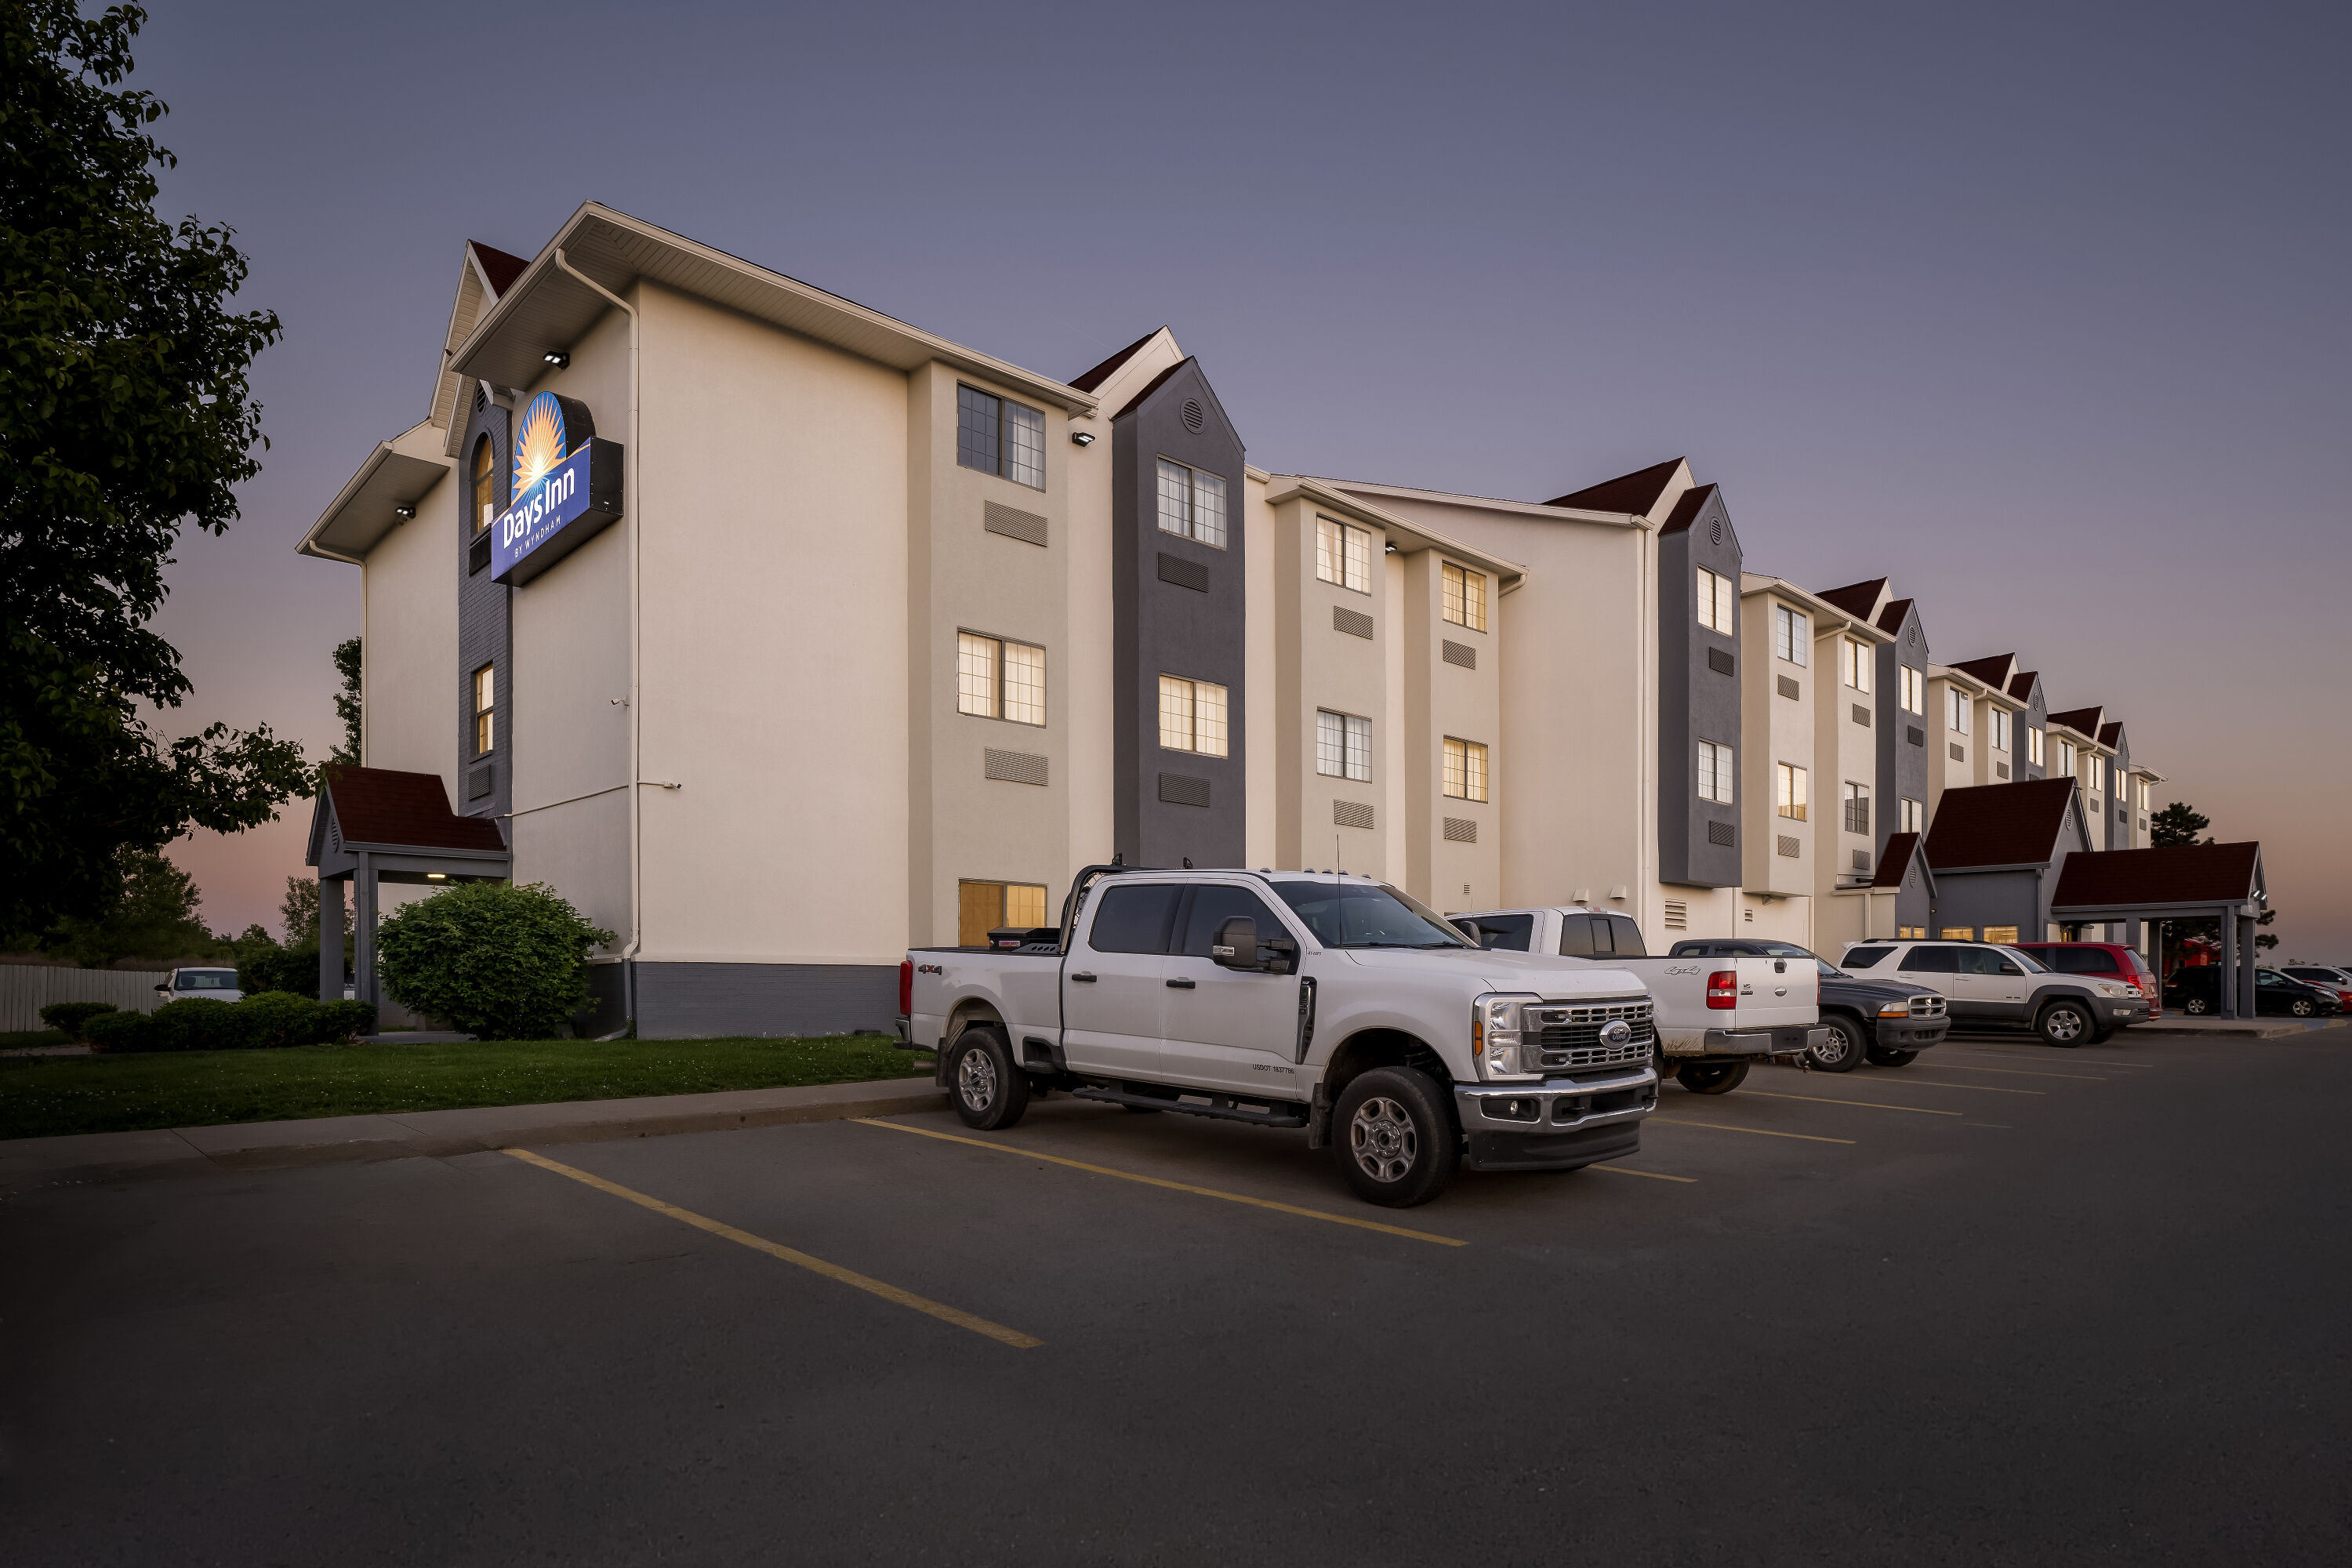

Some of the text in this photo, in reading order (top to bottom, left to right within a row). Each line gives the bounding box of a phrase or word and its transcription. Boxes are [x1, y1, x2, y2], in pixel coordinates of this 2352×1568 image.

[503, 467, 575, 549] Days Inn
[515, 514, 561, 558] BY WYNDHAM
[1252, 1063, 1271, 1072] USDOT
